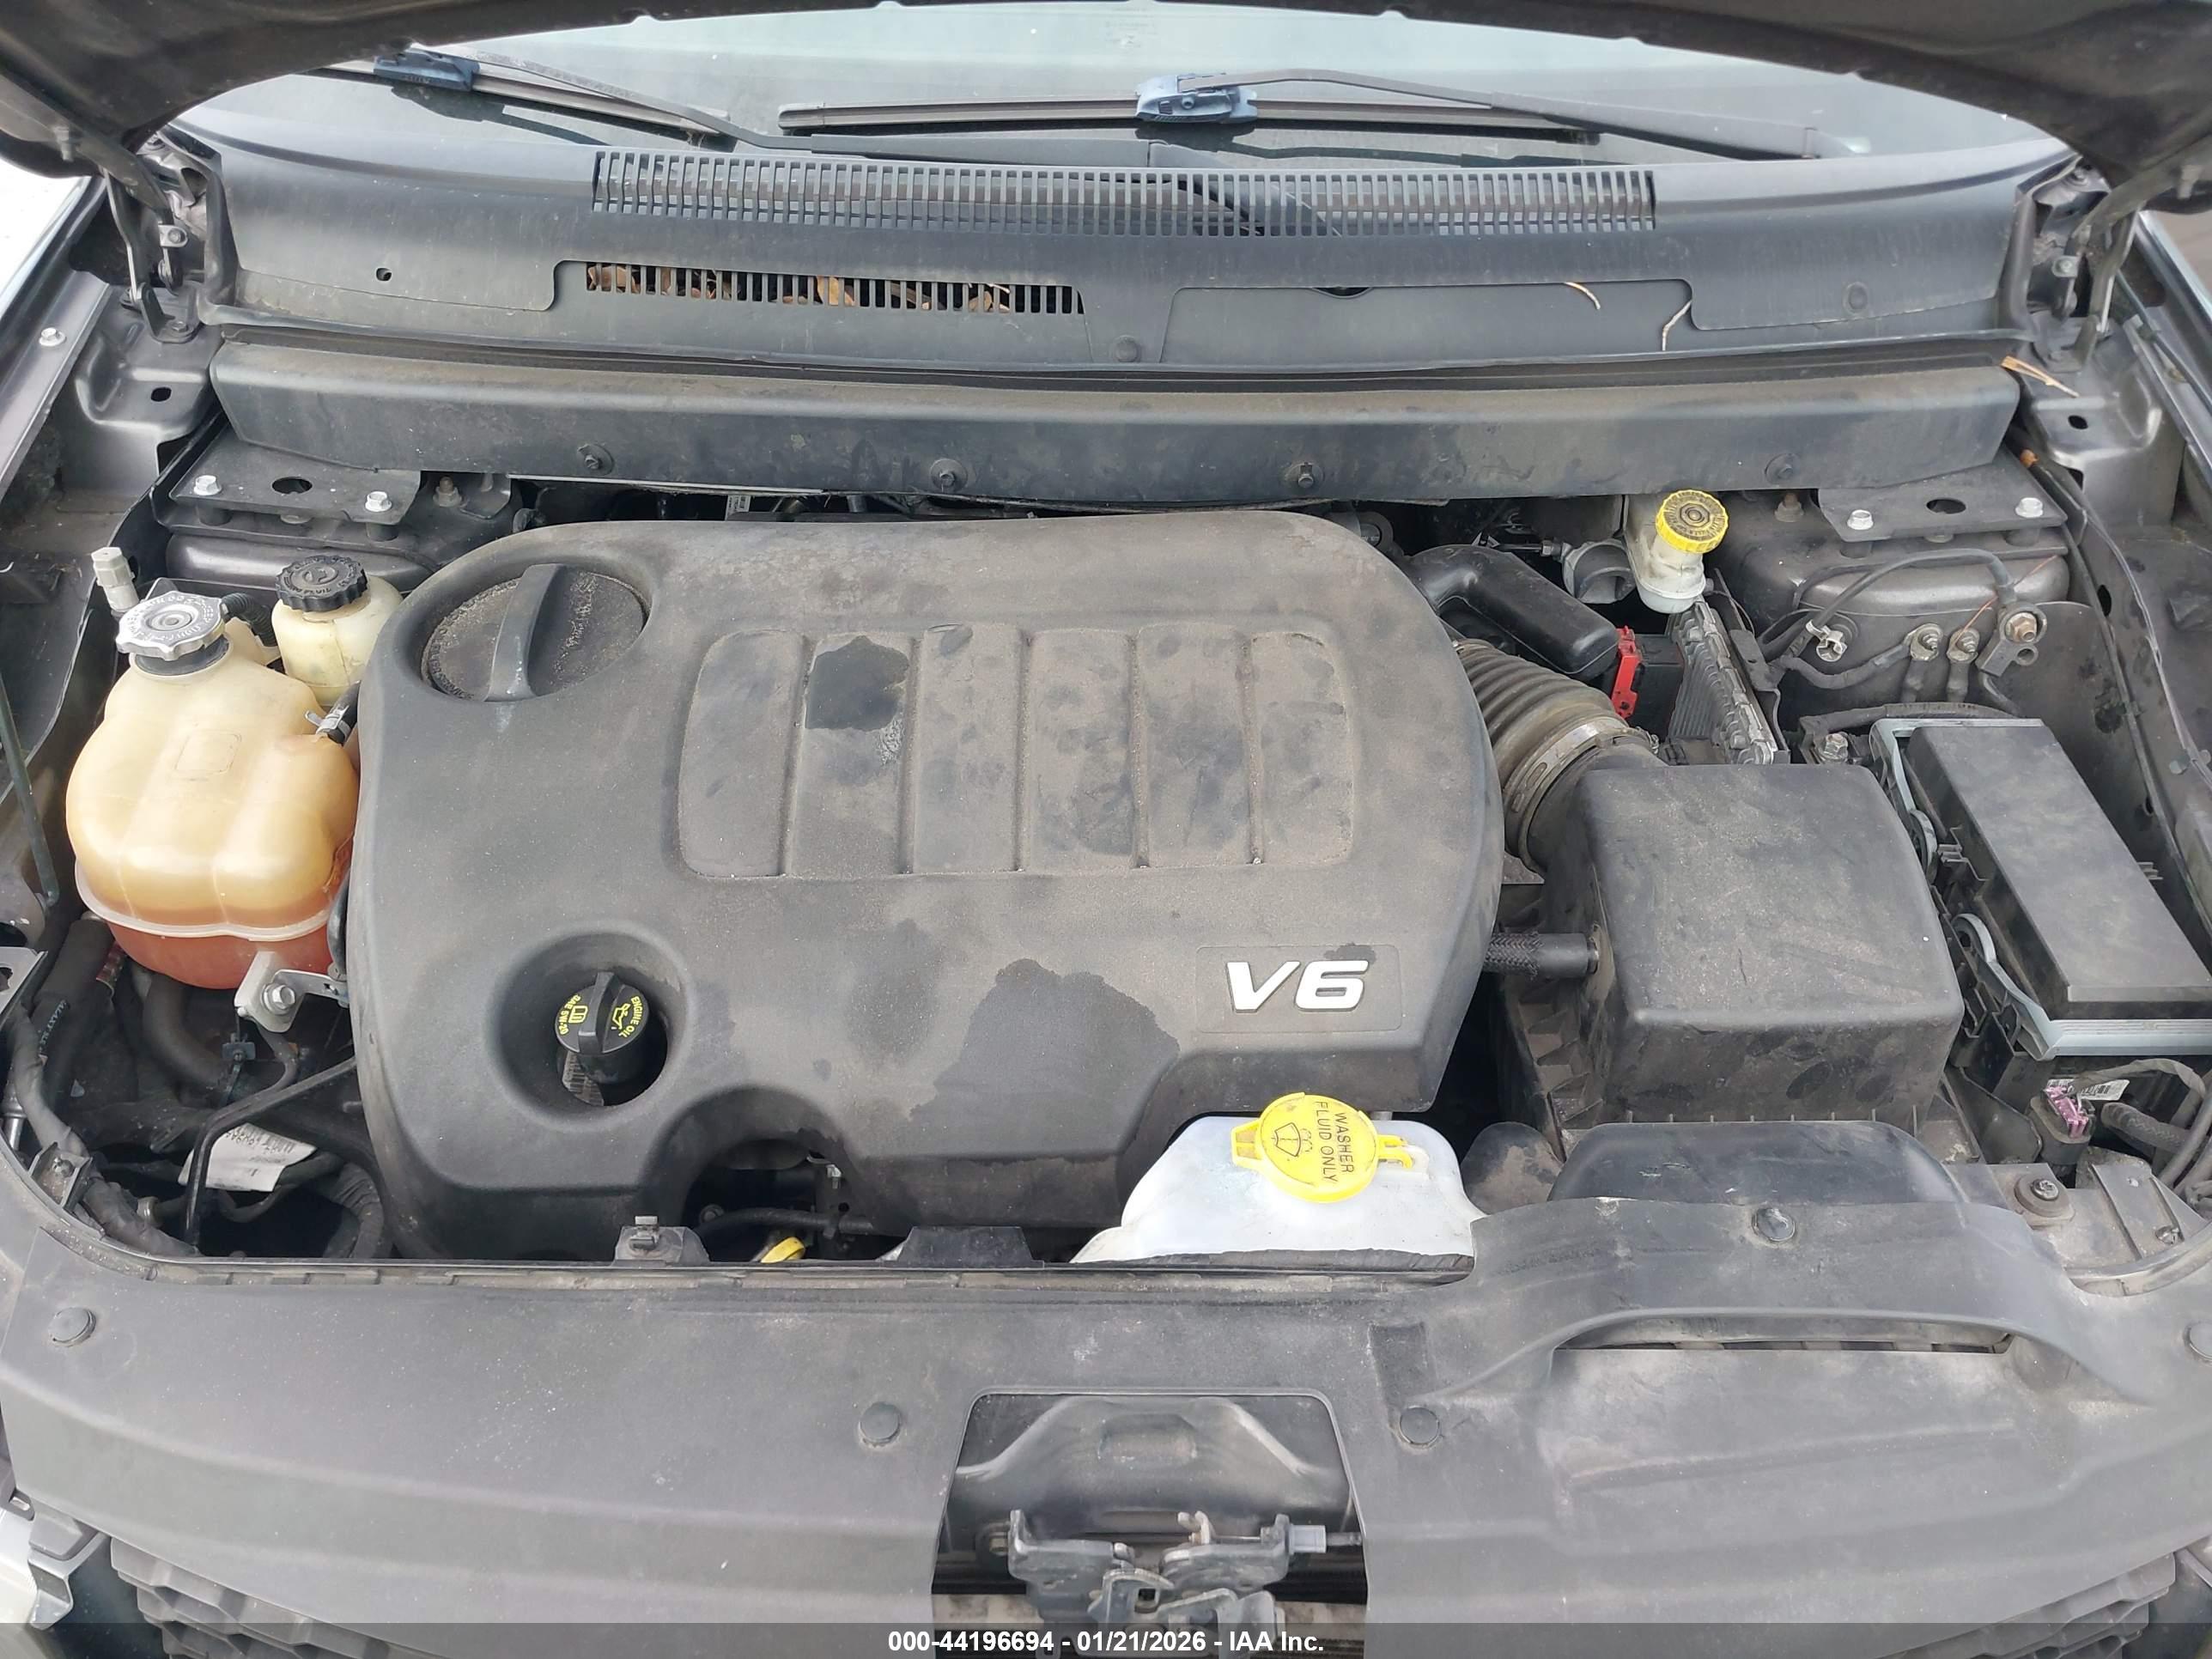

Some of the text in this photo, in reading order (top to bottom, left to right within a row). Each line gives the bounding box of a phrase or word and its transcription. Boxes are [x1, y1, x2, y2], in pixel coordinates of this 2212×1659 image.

[1226, 960, 1370, 1013] V6
[557, 1010, 570, 1035] 5W-20
[618, 995, 643, 1038] ENGINE OIL
[1315, 1101, 1338, 1182] FLUID ONLY
[1334, 1112, 1354, 1173] WASHER
